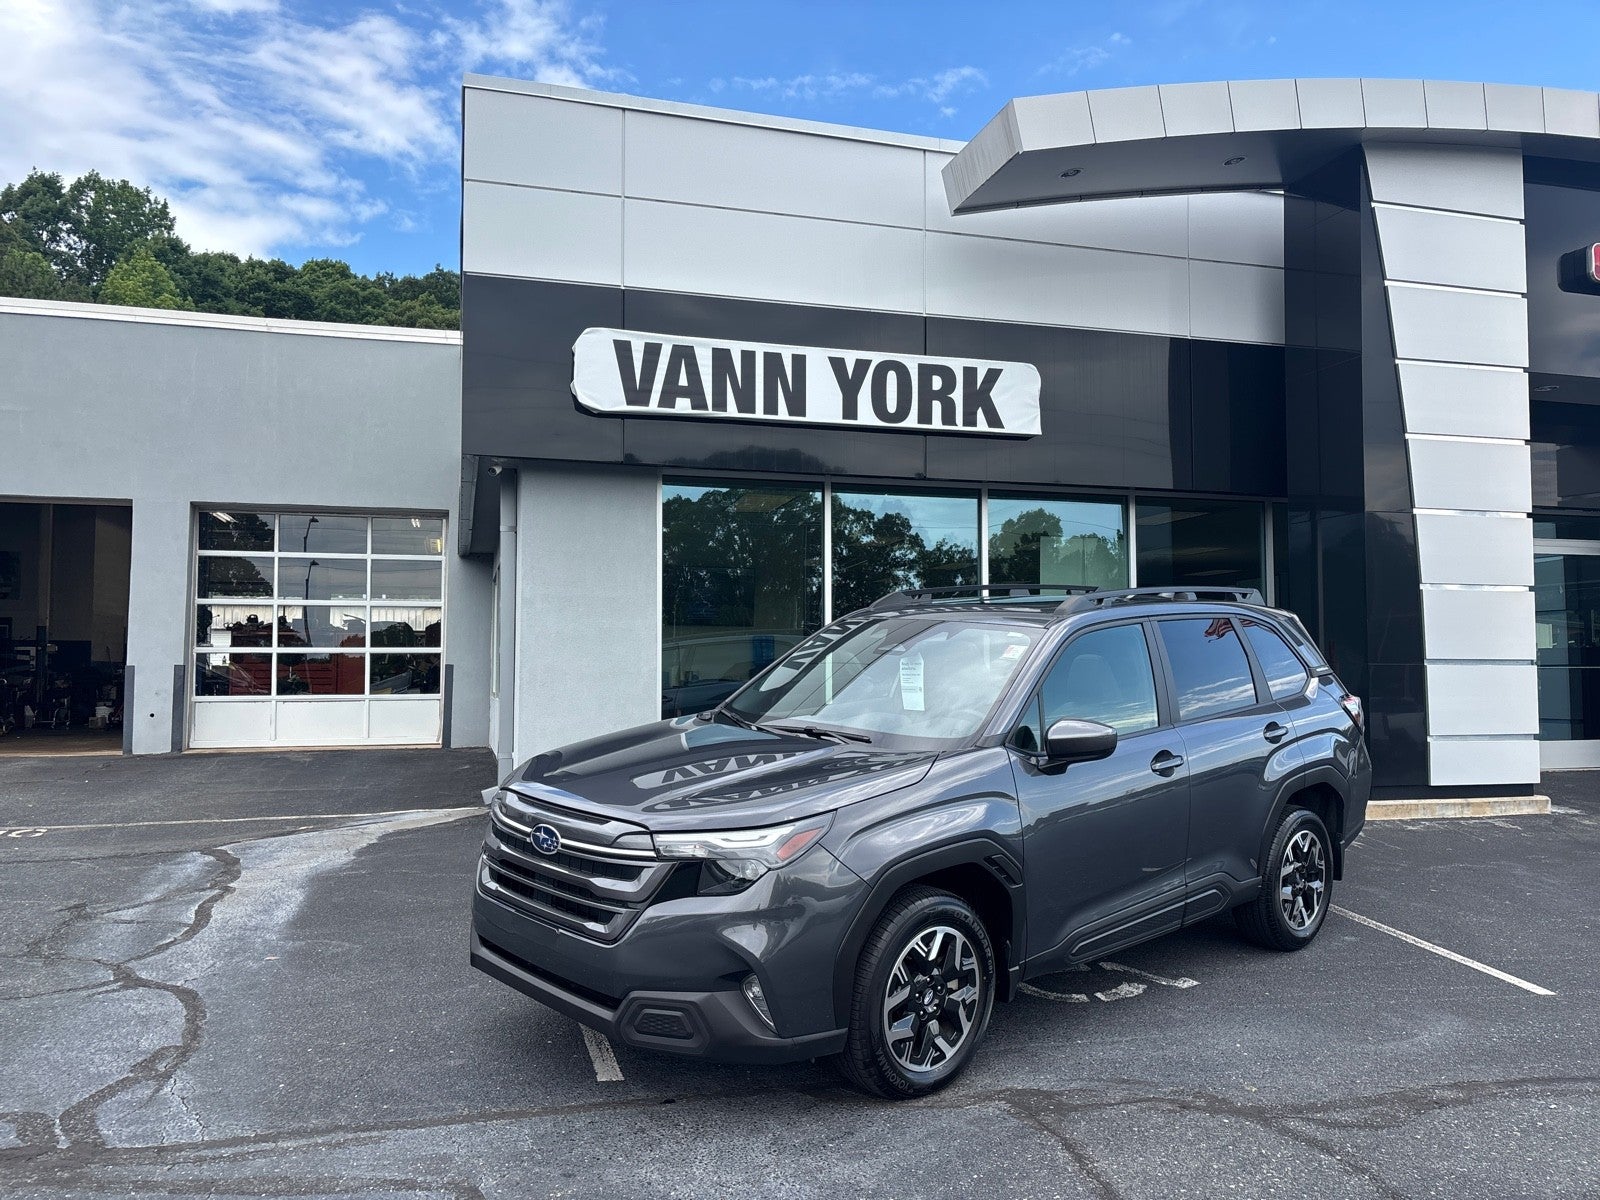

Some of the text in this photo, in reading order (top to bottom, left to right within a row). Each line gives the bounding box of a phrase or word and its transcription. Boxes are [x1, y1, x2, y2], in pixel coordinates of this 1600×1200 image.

[612, 339, 1006, 429] VANN YORK
[875, 1046, 910, 1092] YOKOHAMA
